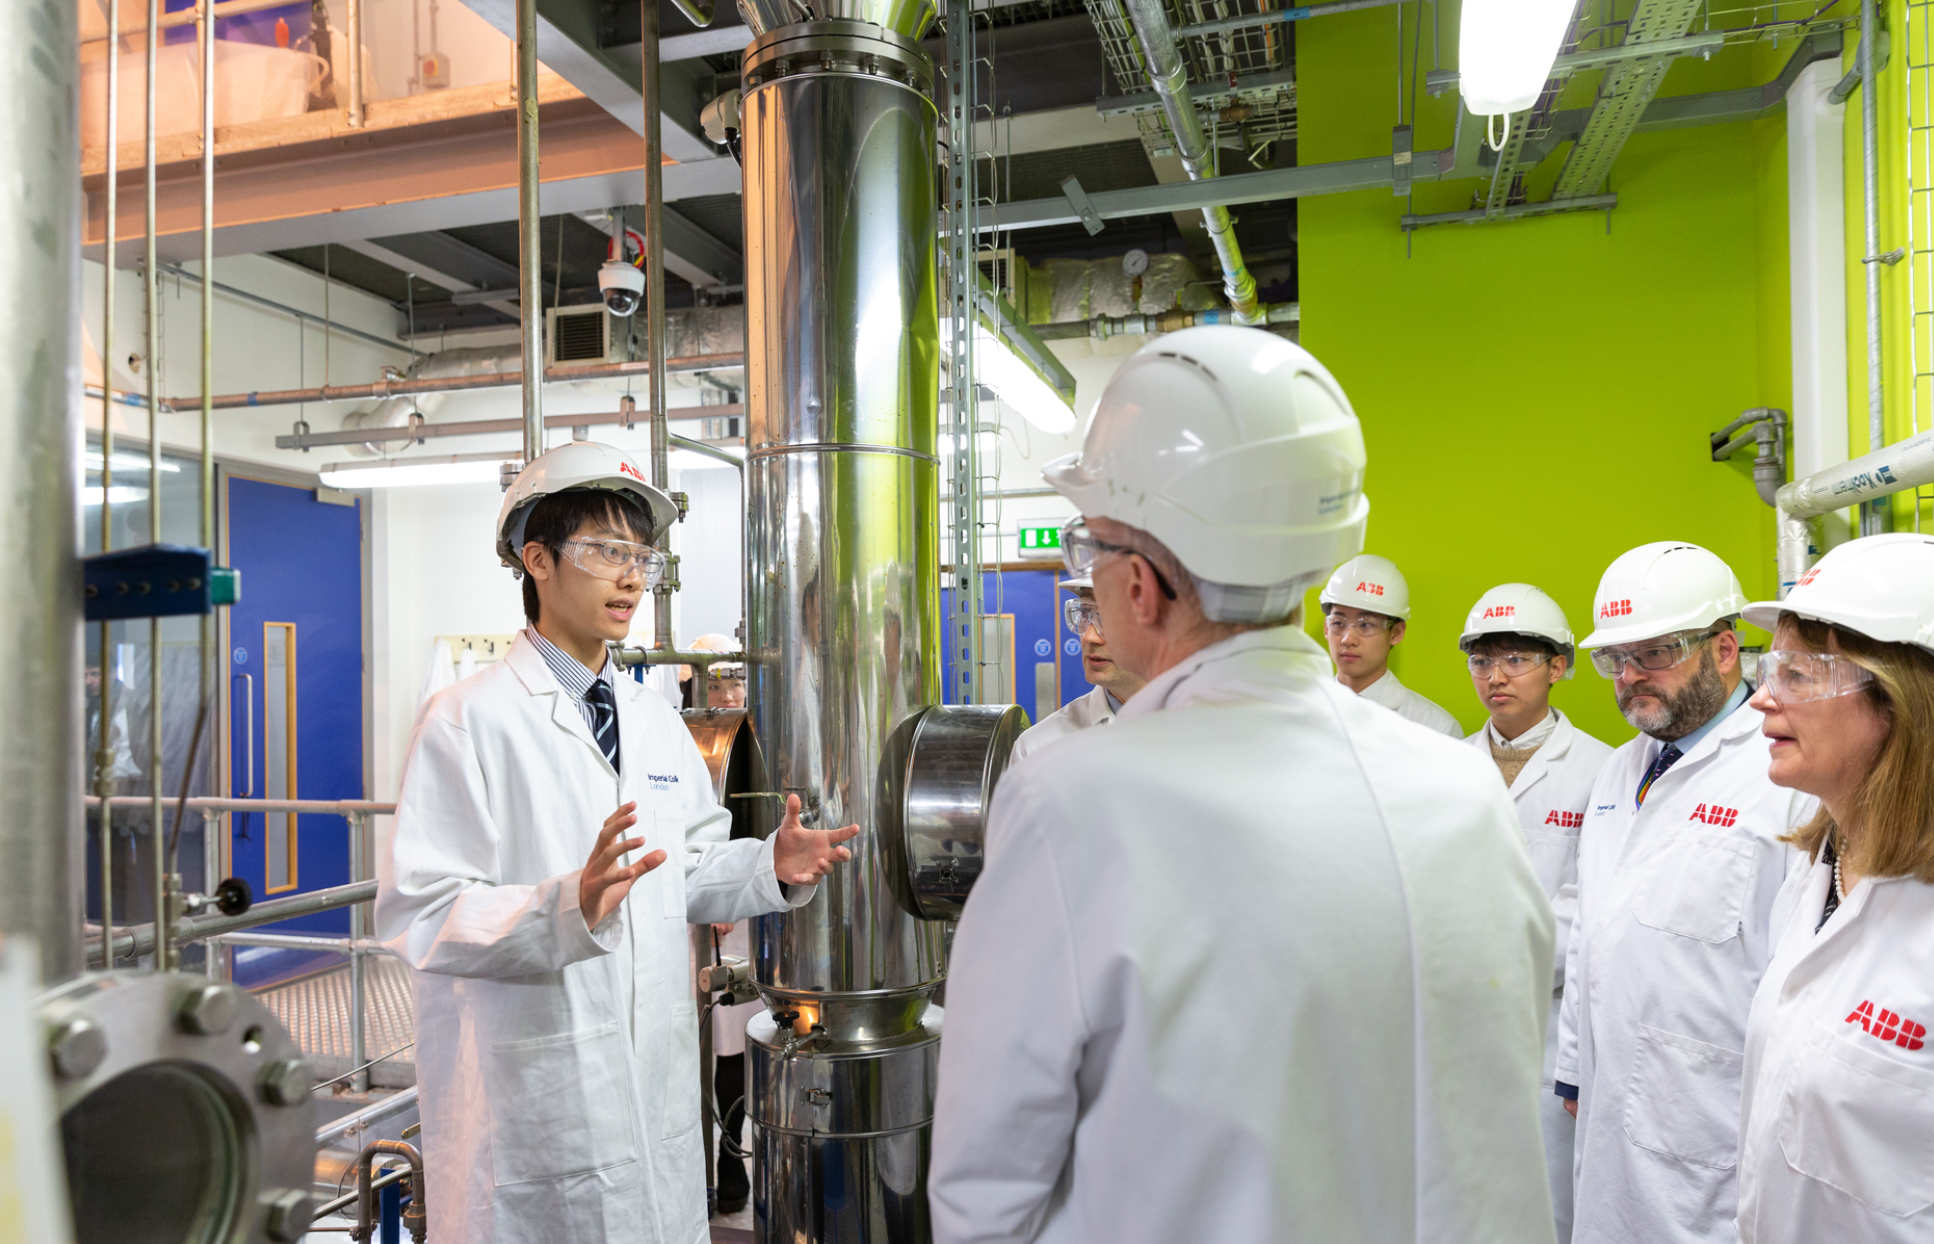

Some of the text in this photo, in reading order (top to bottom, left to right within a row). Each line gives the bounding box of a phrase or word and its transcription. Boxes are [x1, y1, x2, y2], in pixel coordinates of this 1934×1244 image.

[1483, 605, 1516, 620] ABB
[1600, 599, 1633, 620] ABB
[1544, 809, 1585, 828] ABB
[1687, 802, 1739, 827] ABB
[1844, 999, 1926, 1051] ABB
